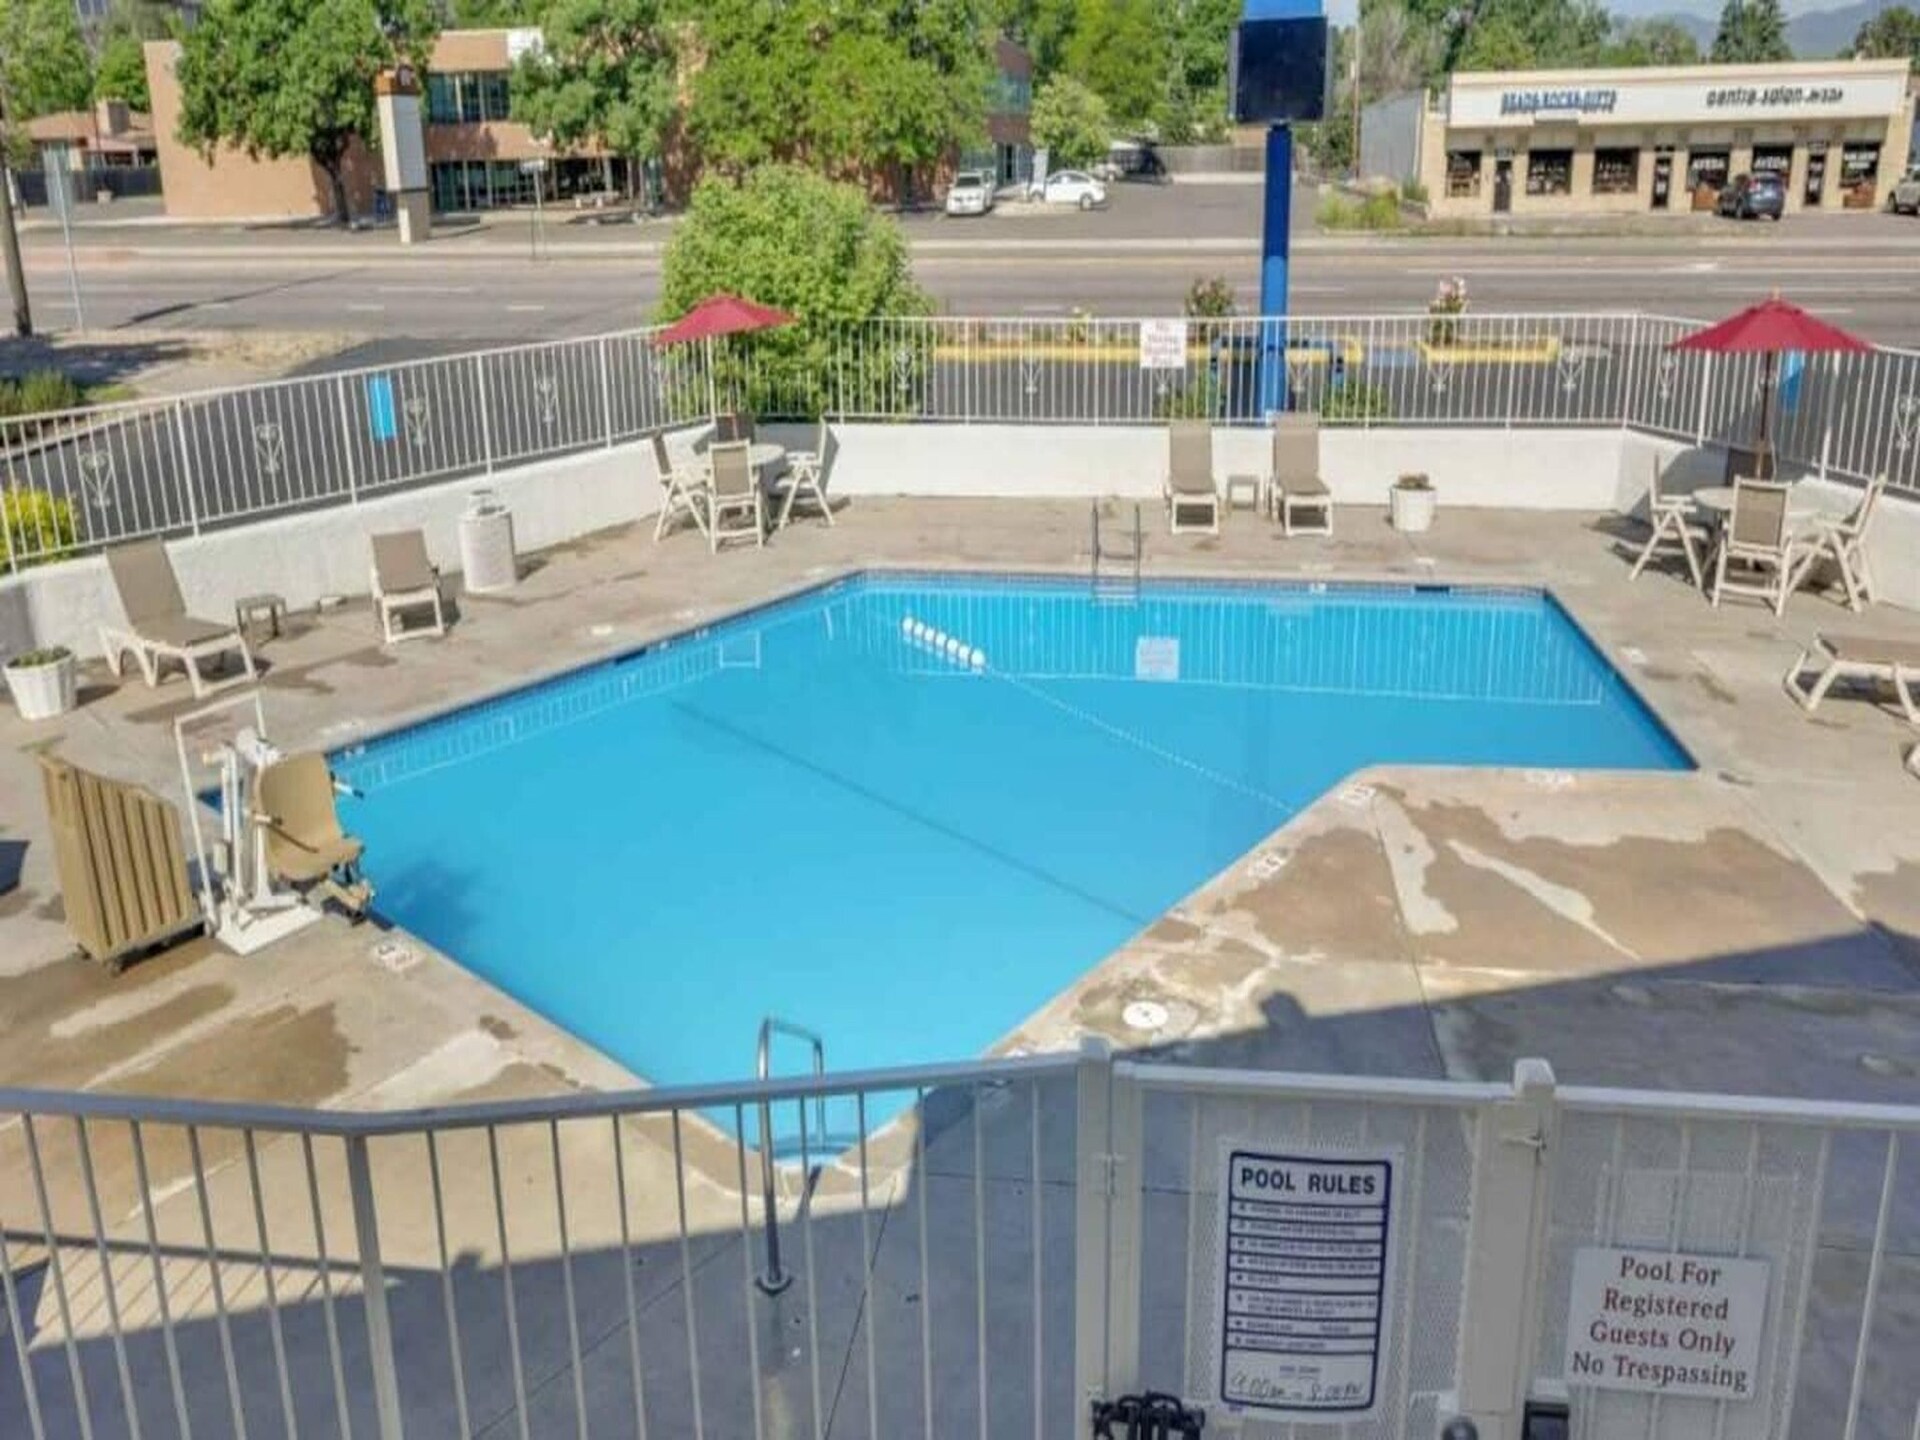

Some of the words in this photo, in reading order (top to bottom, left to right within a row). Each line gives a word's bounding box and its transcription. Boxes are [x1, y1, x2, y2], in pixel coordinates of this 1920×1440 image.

[1241, 1168, 1296, 1191] POOL
[1308, 1175, 1375, 1195] RULES
[1620, 1256, 1674, 1282] Pool
[1680, 1262, 1721, 1286] For
[1603, 1287, 1728, 1320] Registered
[1589, 1320, 1669, 1348] Guests
[1678, 1328, 1735, 1359] Only
[1572, 1351, 1603, 1375] No
[1613, 1355, 1747, 1392] Trespassing
